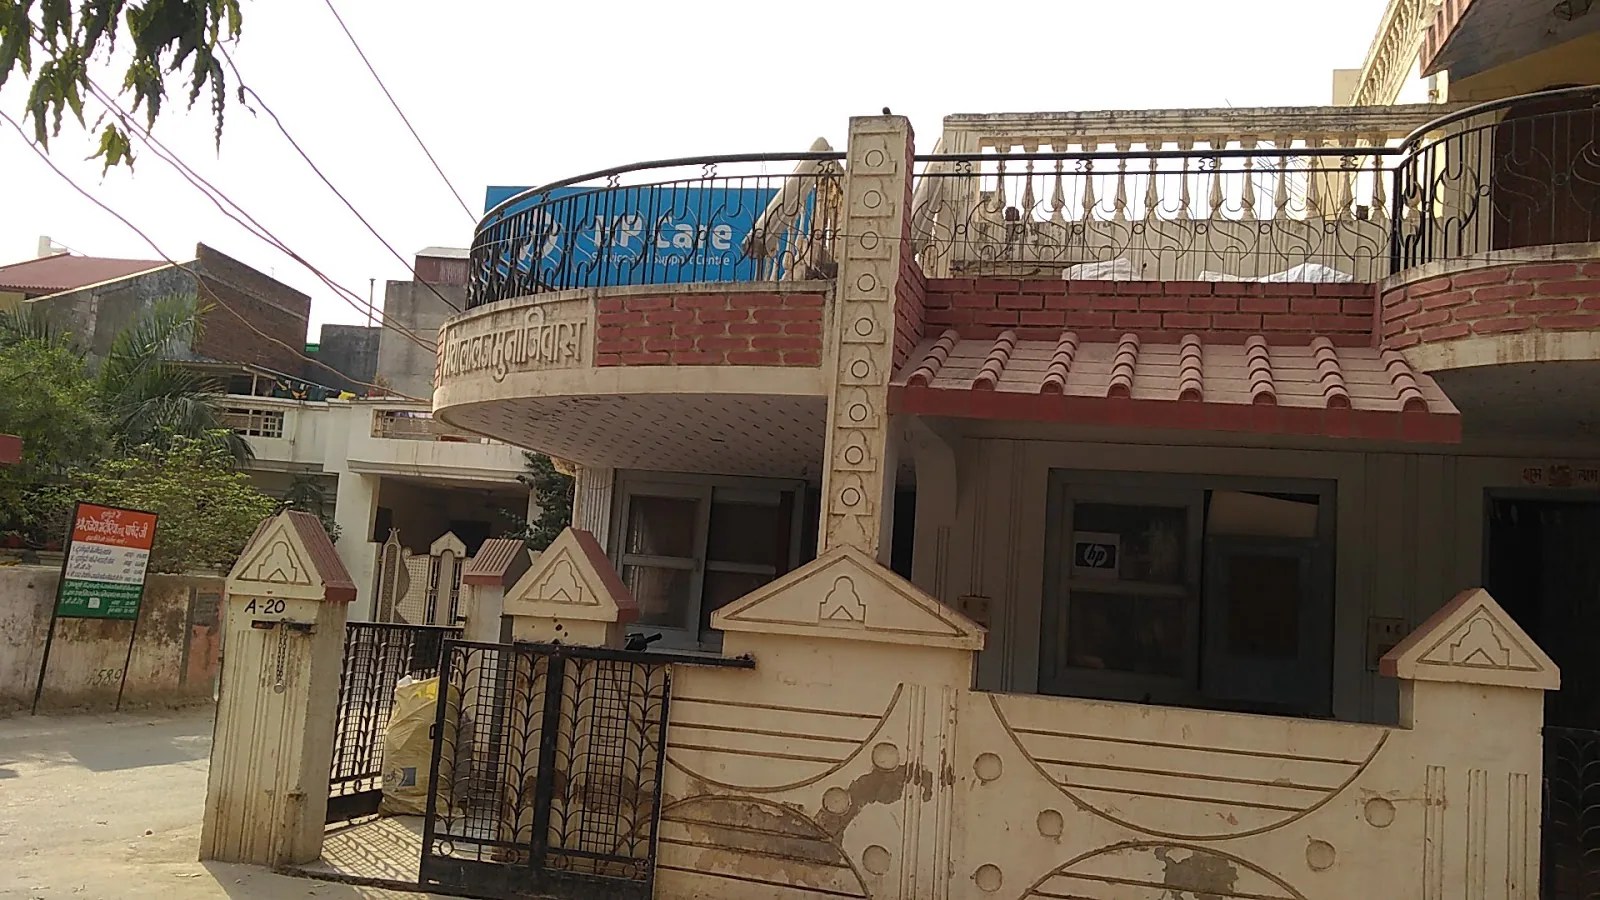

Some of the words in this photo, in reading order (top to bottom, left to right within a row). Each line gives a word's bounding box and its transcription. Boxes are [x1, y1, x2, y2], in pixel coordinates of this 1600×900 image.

[594, 215, 643, 248] HP
[653, 215, 732, 250] Care
[591, 251, 629, 264] Srvice
[653, 252, 694, 267] Suppot
[244, 598, 286, 615] A-20
